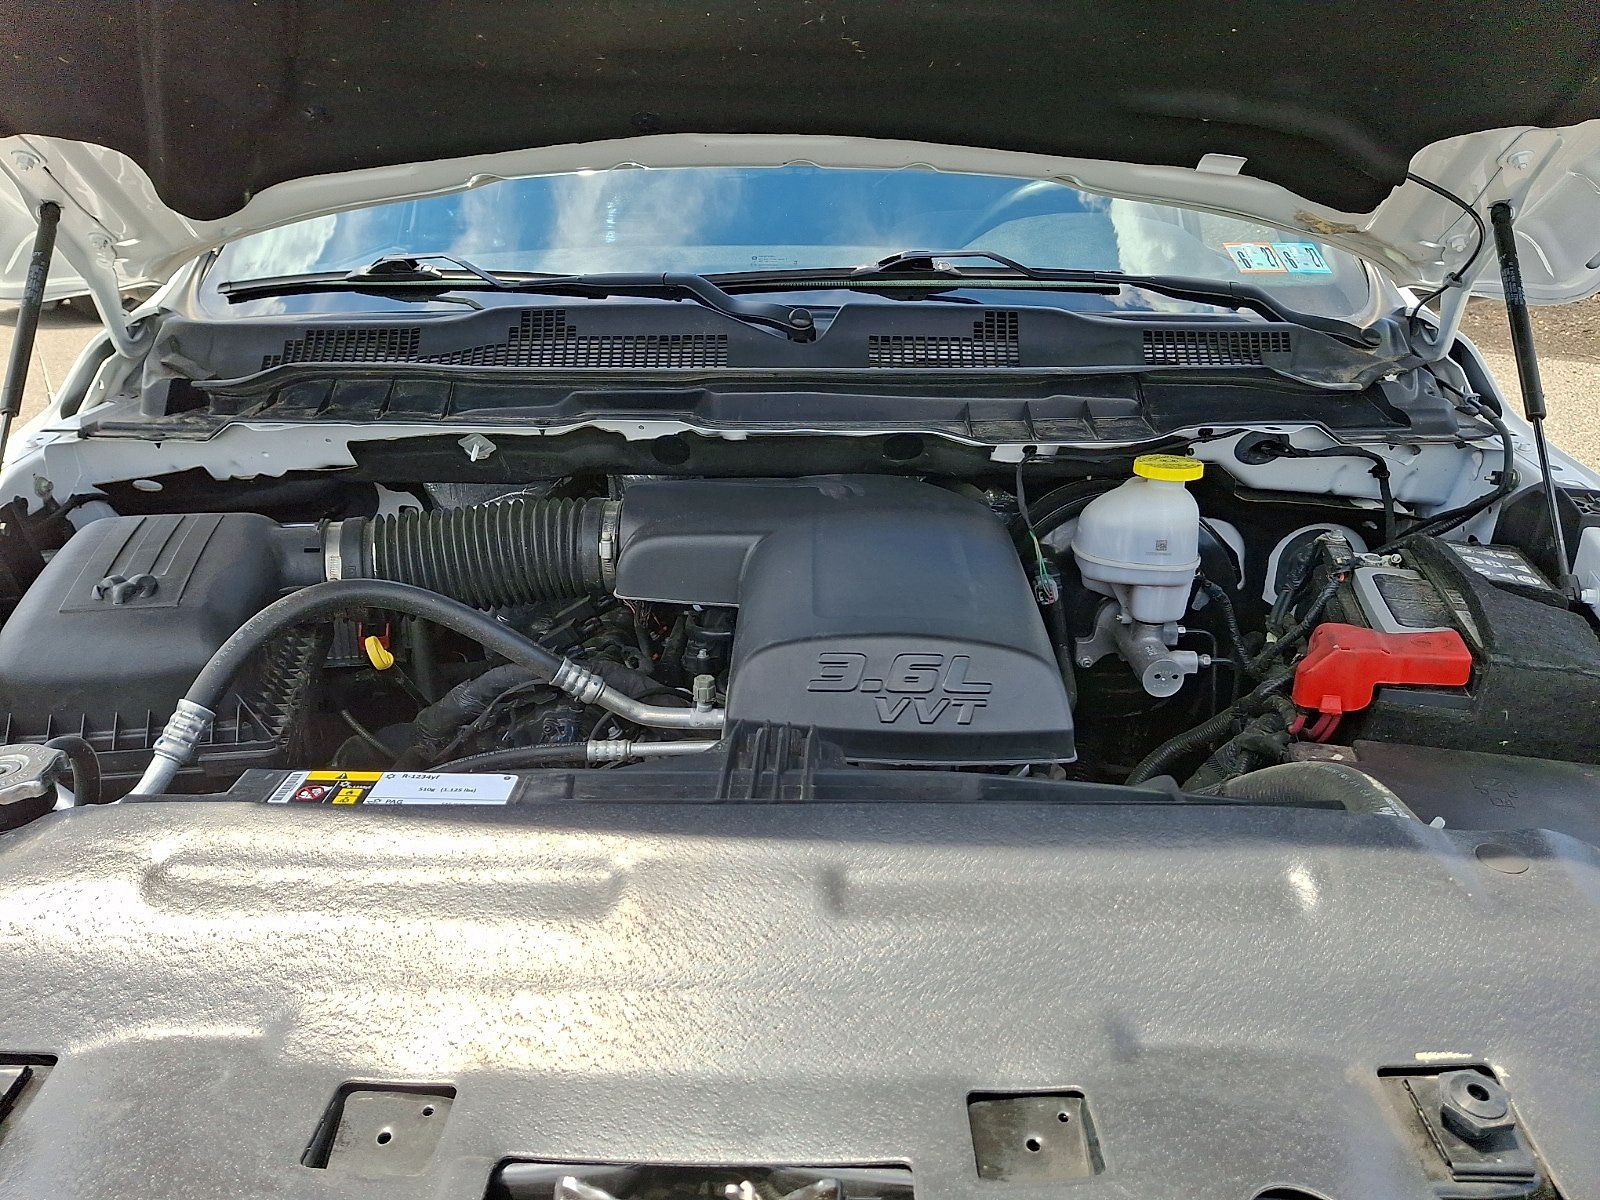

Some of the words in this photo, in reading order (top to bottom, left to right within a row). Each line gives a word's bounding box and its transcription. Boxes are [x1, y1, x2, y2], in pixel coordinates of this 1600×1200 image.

[1237, 250, 1252, 269] 6
[1283, 250, 1298, 269] 6
[807, 652, 993, 694] 3.6L
[874, 696, 988, 725] VVT
